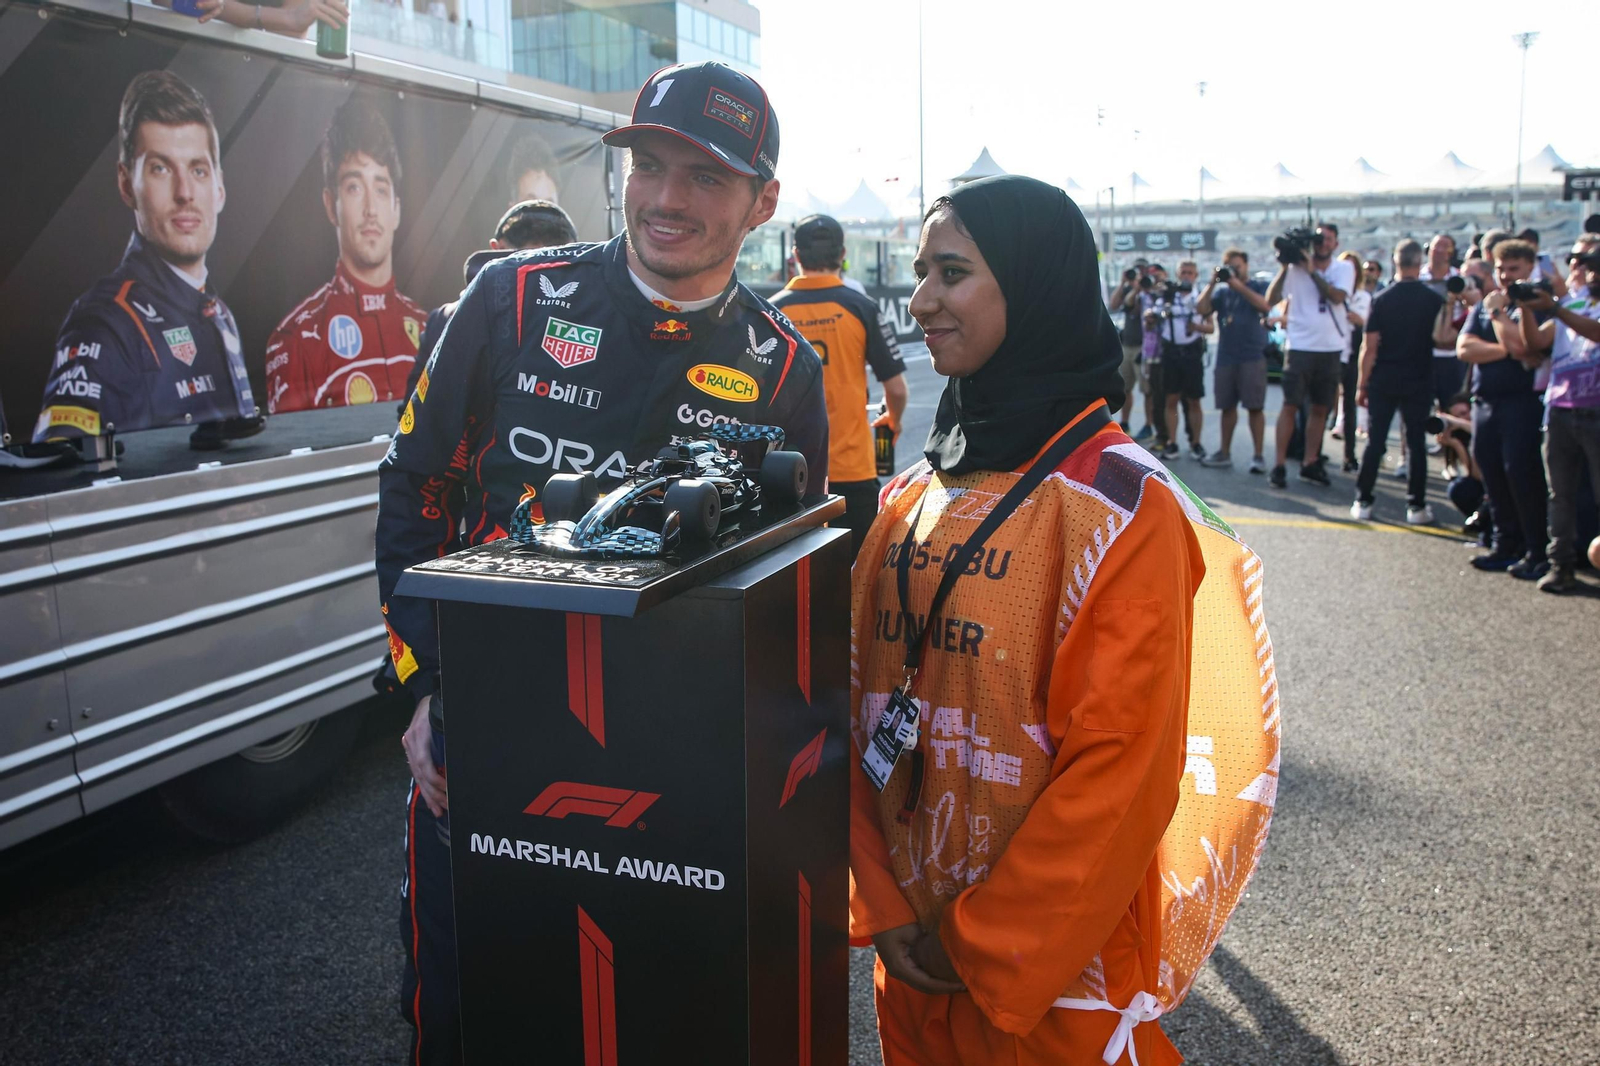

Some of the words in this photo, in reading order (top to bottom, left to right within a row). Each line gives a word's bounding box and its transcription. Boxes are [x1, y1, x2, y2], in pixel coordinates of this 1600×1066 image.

[649, 78, 675, 108] 1
[715, 93, 754, 119] ORACLE
[711, 108, 750, 132] RACING
[362, 294, 386, 312] IBM
[535, 298, 571, 309] CASTORE
[552, 321, 596, 344] TAG
[791, 316, 837, 327] cLaren
[166, 329, 191, 345] TAG
[334, 318, 357, 359] hp
[650, 332, 669, 341] Red
[670, 332, 692, 341] Bull
[56, 341, 102, 369] Mobil
[545, 338, 594, 365] HEUER
[56, 380, 102, 400] ADE
[175, 376, 208, 399] Mobil
[517, 372, 578, 404] Mobil
[706, 372, 754, 397] RAUCH
[508, 427, 653, 480] ORA
[463, 555, 586, 570] MARSHAL
[595, 565, 640, 574] OF
[495, 563, 566, 576] YEAR
[567, 568, 641, 583] 2025
[470, 832, 610, 875] MARSHAL
[614, 855, 726, 891] AWARD
